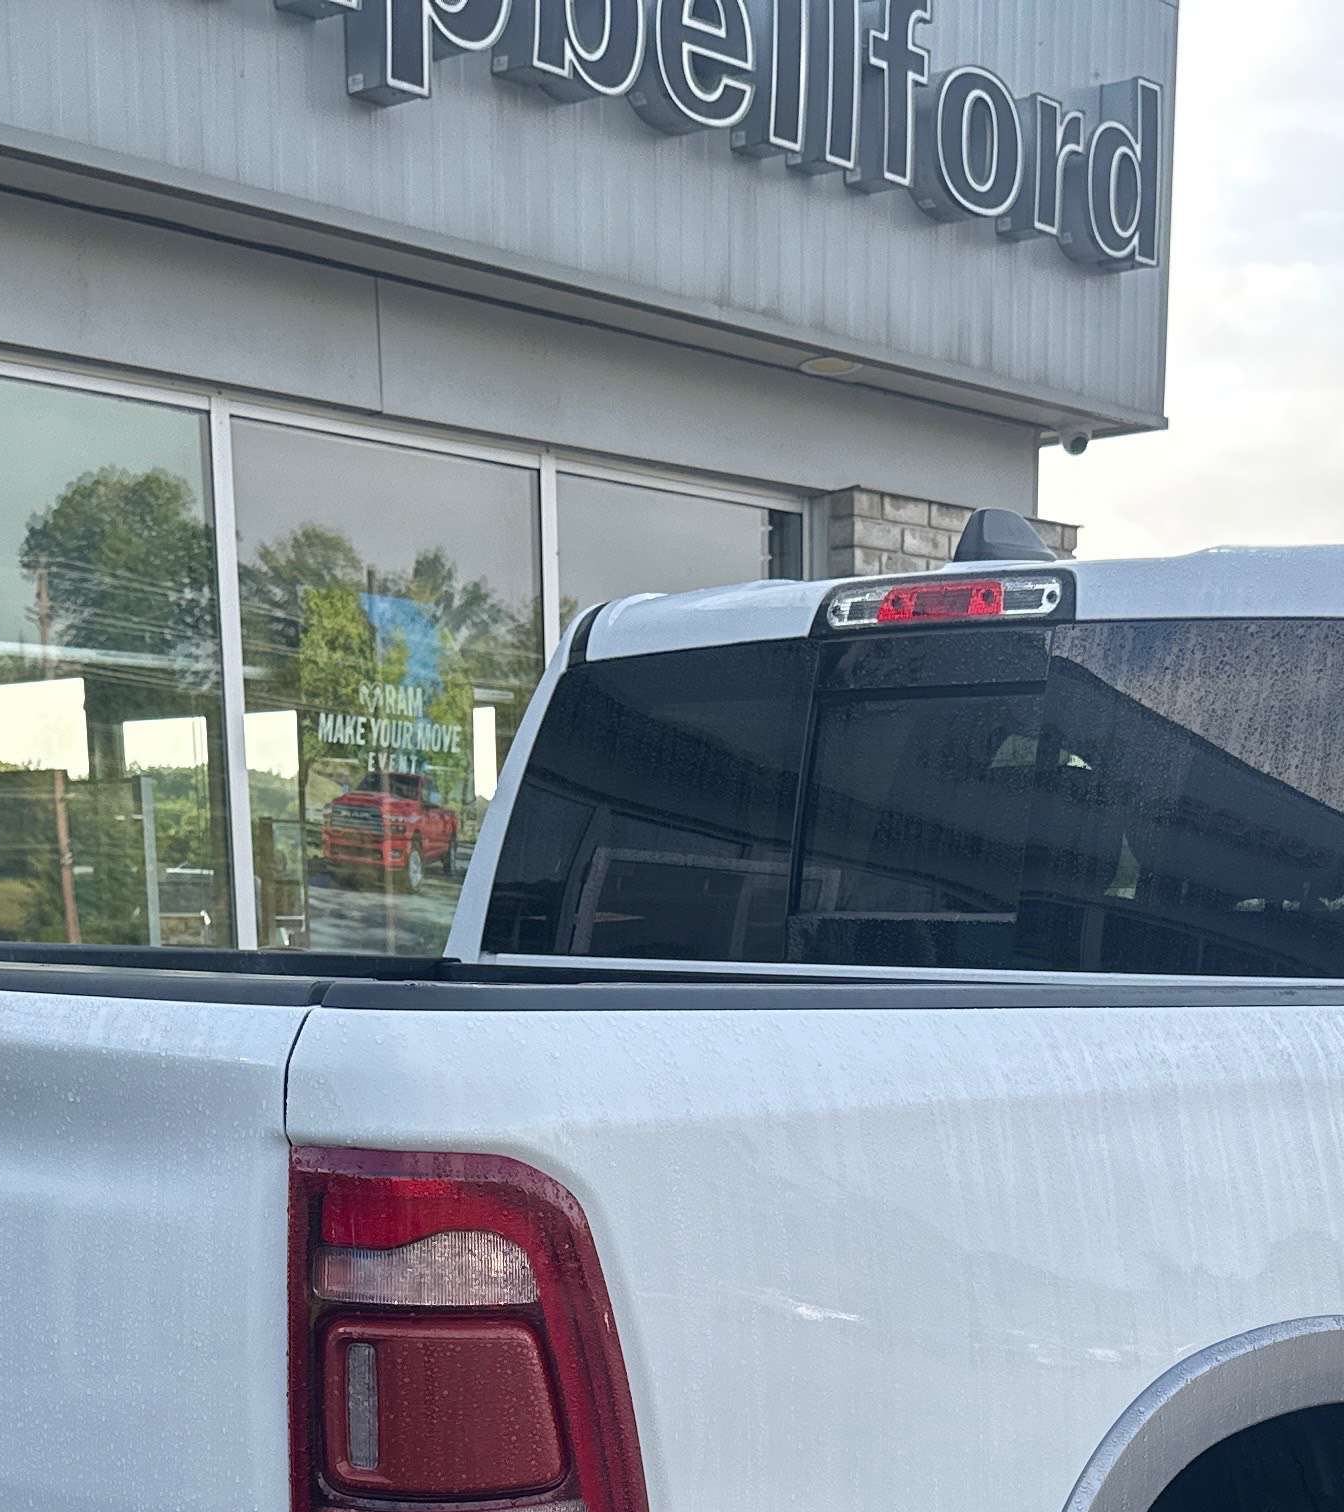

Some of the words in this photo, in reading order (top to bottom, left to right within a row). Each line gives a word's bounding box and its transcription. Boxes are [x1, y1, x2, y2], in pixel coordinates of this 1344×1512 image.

[331, 0, 1161, 266] bellford
[384, 684, 424, 717] RAM
[318, 713, 367, 745] MAKE
[370, 718, 413, 748] YOUR
[417, 723, 462, 753] MOVE
[368, 752, 417, 774] EVENT
